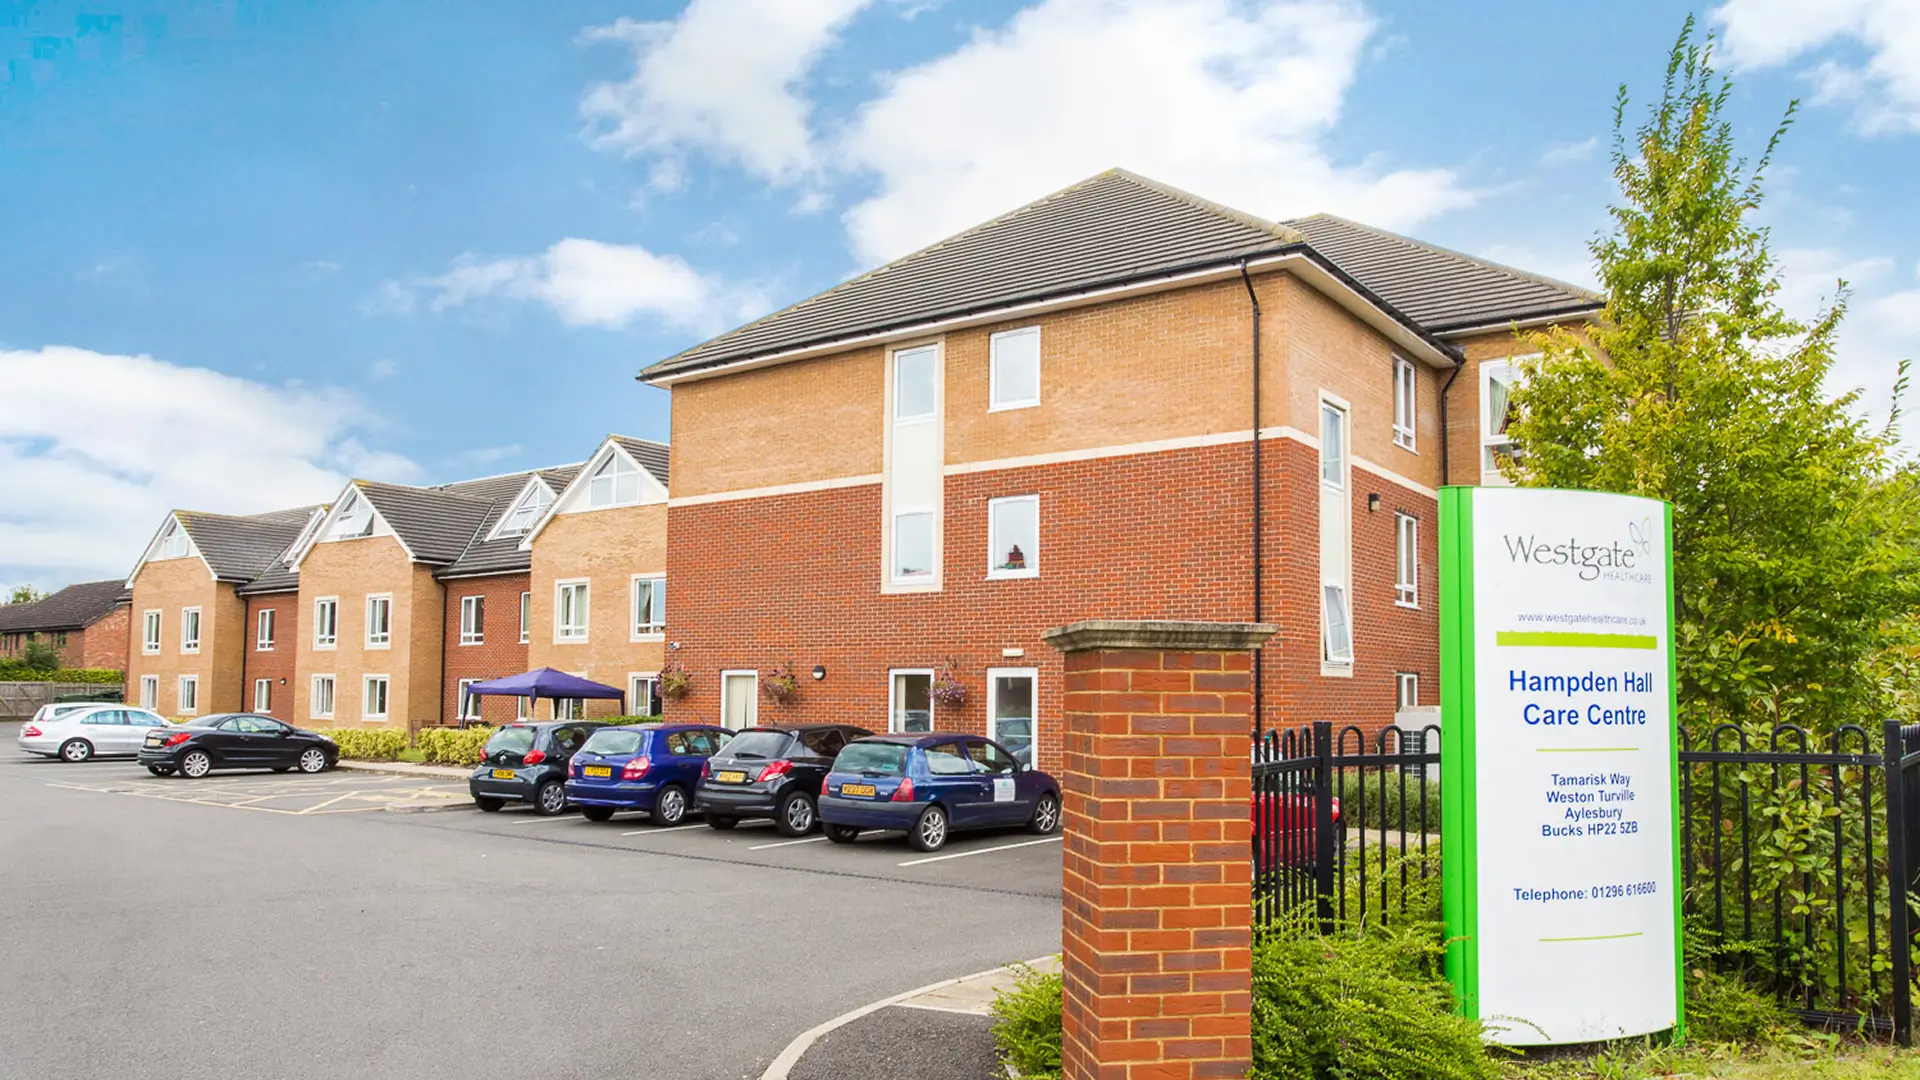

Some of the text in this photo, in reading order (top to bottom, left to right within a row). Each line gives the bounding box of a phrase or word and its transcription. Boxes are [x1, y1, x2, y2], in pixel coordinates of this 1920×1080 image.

[1503, 534, 1635, 581] Westgate
[1603, 572, 1652, 584] HEALTHCARE
[1510, 670, 1652, 697] Hampden Hall
[1524, 704, 1646, 725] Care Centre
[1551, 773, 1630, 787] Tamarisk Way
[1546, 790, 1635, 803] Weston Turville
[1564, 806, 1623, 822] Aylesbury
[1542, 821, 1638, 836] Bucks HP22 5ZB
[1514, 881, 1656, 903] Telephone: 01296 616600
